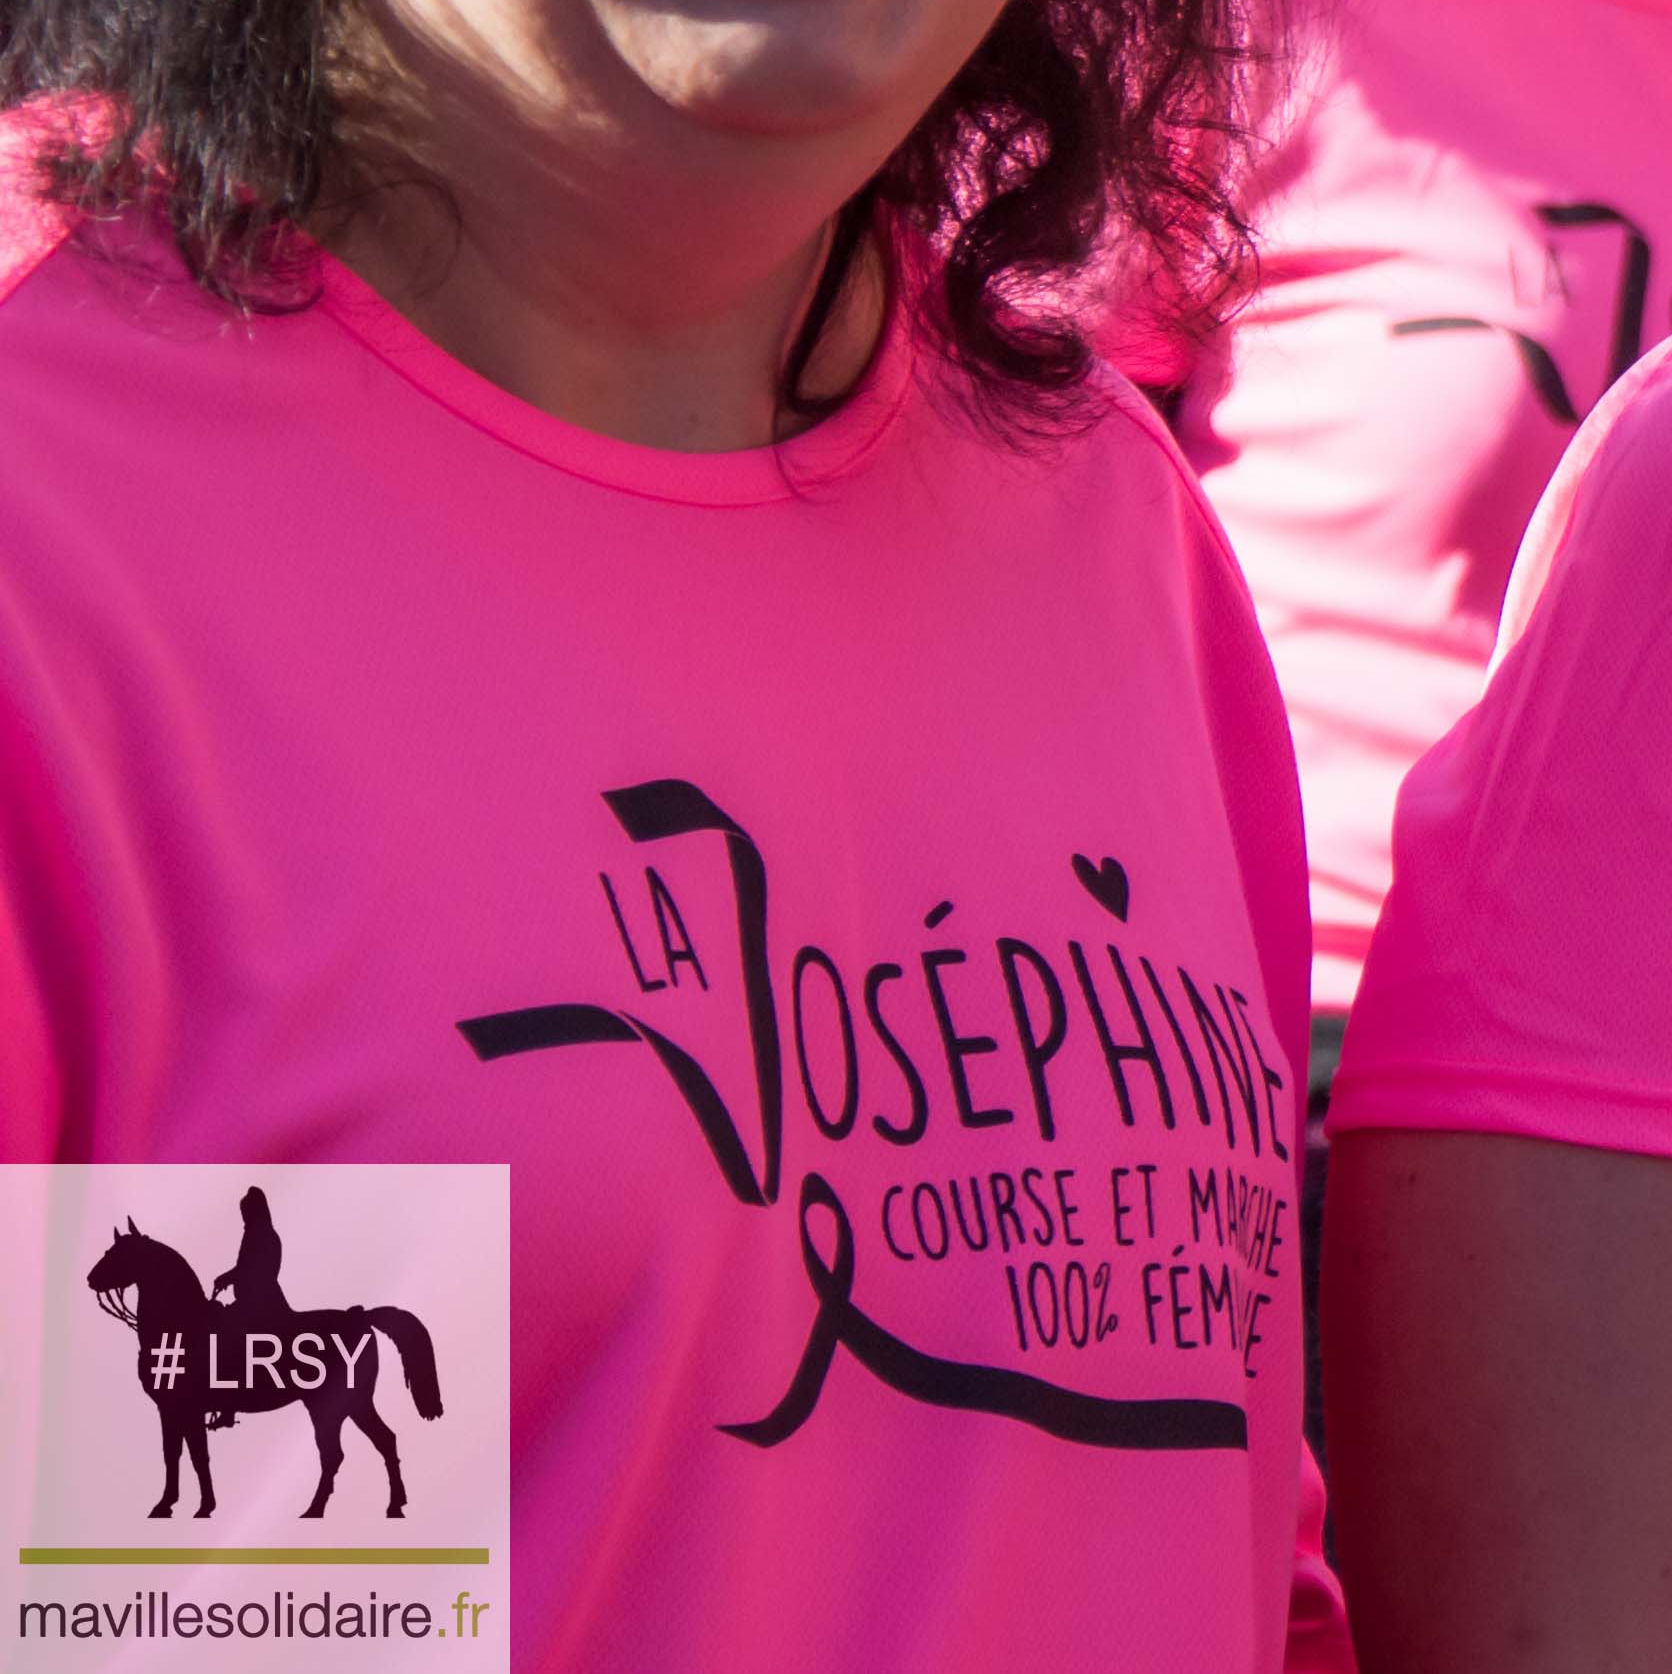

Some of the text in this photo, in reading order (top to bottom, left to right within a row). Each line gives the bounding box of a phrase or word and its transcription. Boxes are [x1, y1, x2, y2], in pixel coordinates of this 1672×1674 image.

[455, 778, 1290, 1206] LA JOSÉPHINE
[881, 1164, 1288, 1278] COURSE ET MARCHE
[1005, 1260, 1119, 1353] 100%
